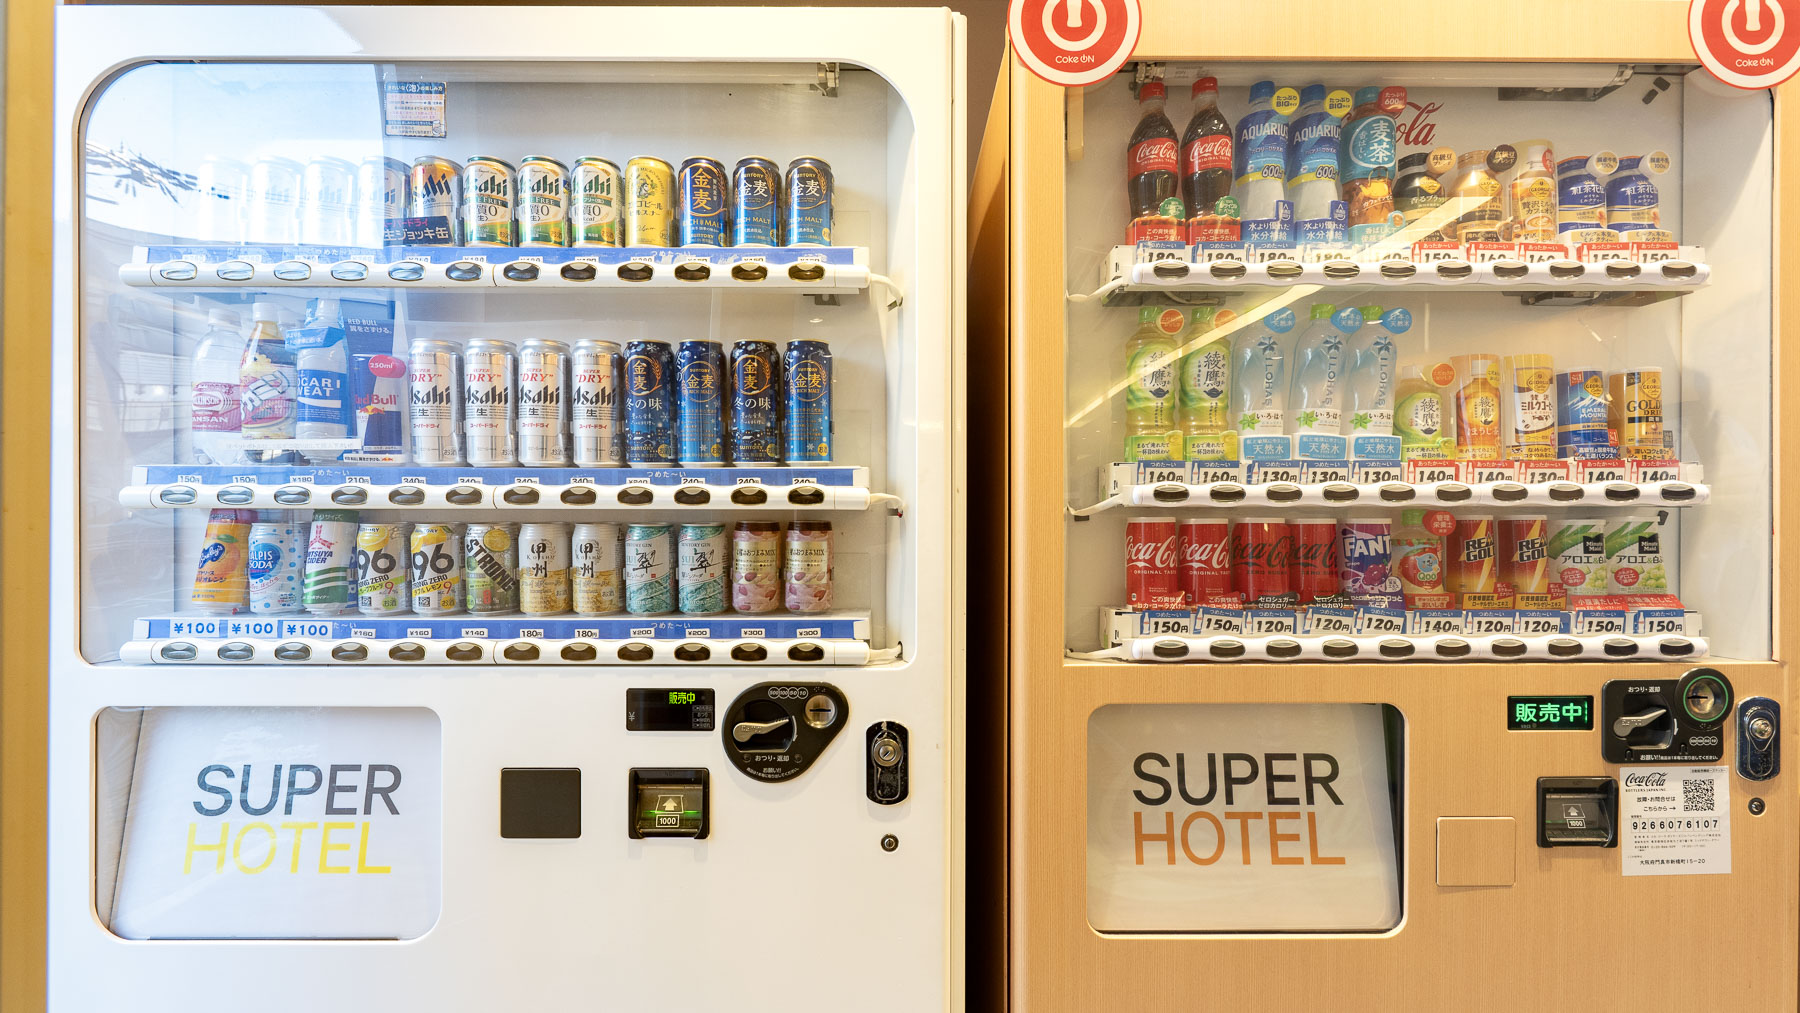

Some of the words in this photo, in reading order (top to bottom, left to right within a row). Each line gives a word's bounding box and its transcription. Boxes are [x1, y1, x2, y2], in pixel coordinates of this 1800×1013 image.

[1055, 55, 1079, 63] Coke
[1080, 54, 1094, 63] ON
[1736, 59, 1758, 67] Coke
[1760, 57, 1773, 66] ON
[1241, 122, 1288, 143] AQUARIUS
[1369, 120, 1391, 164] 麦茶
[691, 168, 712, 210] 金麦
[1641, 242, 1672, 250] あったか〜い
[1204, 351, 1222, 387] 綾鷹
[633, 360, 647, 390] 金麦
[743, 360, 757, 390] 金麦
[687, 374, 714, 389] 金麦
[795, 373, 822, 389] 金麦
[371, 394, 397, 405] Bull
[626, 397, 662, 411] 冬の味
[734, 397, 771, 411] 冬の味
[476, 408, 488, 416] 生
[528, 408, 539, 416] 生
[586, 409, 597, 417] 生
[1253, 444, 1284, 454] 天然水
[1309, 443, 1340, 454] 天然水
[1365, 443, 1395, 454] 天然水
[1149, 471, 1183, 483] 160円
[1203, 471, 1237, 483] 160円
[1262, 471, 1297, 483] 130円
[1312, 471, 1346, 483] 130円
[1364, 471, 1399, 483] 130円
[1419, 471, 1454, 482] 140円
[1477, 472, 1512, 482] 140円
[1530, 472, 1564, 482] 130円
[1588, 471, 1623, 482] 140円
[1642, 471, 1677, 482] 140円
[1343, 535, 1391, 557] FANT
[466, 539, 516, 592] STRONG
[370, 574, 390, 583] ZERO
[430, 574, 447, 584] ZERO
[383, 598, 397, 607] お酒
[483, 590, 491, 604] 8
[174, 623, 215, 634] ¥100
[232, 623, 273, 634] ¥100
[287, 625, 328, 636] ¥100
[1153, 621, 1188, 633] 150円
[1206, 618, 1240, 632] 150円
[1257, 621, 1292, 632] 120円
[1315, 618, 1349, 632] 120円
[1366, 618, 1401, 632] 120円
[1425, 621, 1459, 632] 140円
[1476, 621, 1511, 632] 120円
[1524, 621, 1558, 632] 120円
[1587, 621, 1622, 632] 150円
[1649, 621, 1682, 632] 150円
[521, 630, 542, 638] 180円
[576, 630, 597, 638] 180円
[669, 692, 696, 705] 販売中
[1515, 703, 1582, 722] 販売中
[1132, 752, 1344, 806] SUPER
[1625, 772, 1668, 787] Coca-Cola
[193, 764, 402, 816] SUPER
[659, 817, 676, 826] 1000
[1633, 820, 1718, 829] 9266076107
[1134, 811, 1346, 866] HOTEL
[183, 821, 392, 875] HOTEL
